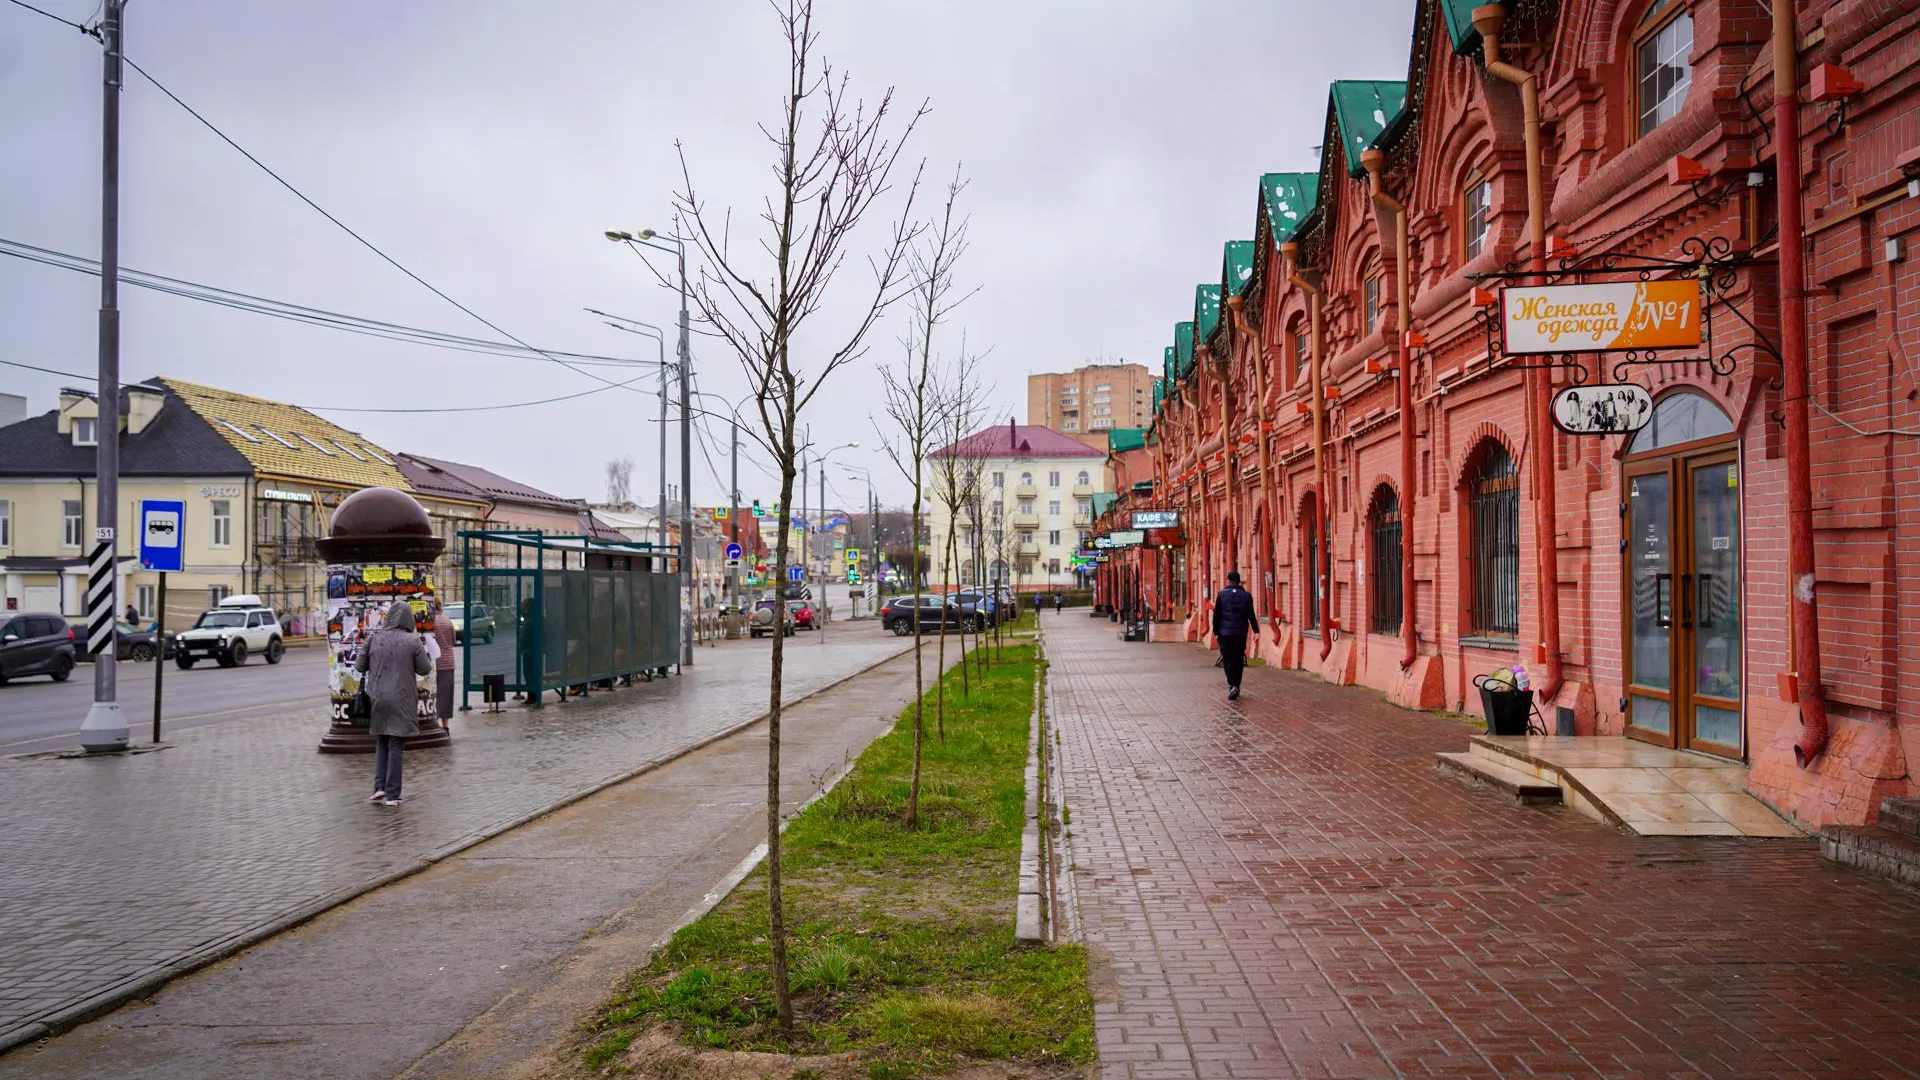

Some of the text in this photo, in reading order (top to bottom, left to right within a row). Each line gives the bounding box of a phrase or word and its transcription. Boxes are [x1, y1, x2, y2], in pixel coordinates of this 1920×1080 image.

[1512, 296, 1617, 321] Женская
[1537, 317, 1620, 344] одежда
[1136, 513, 1161, 522] КАФЕ
